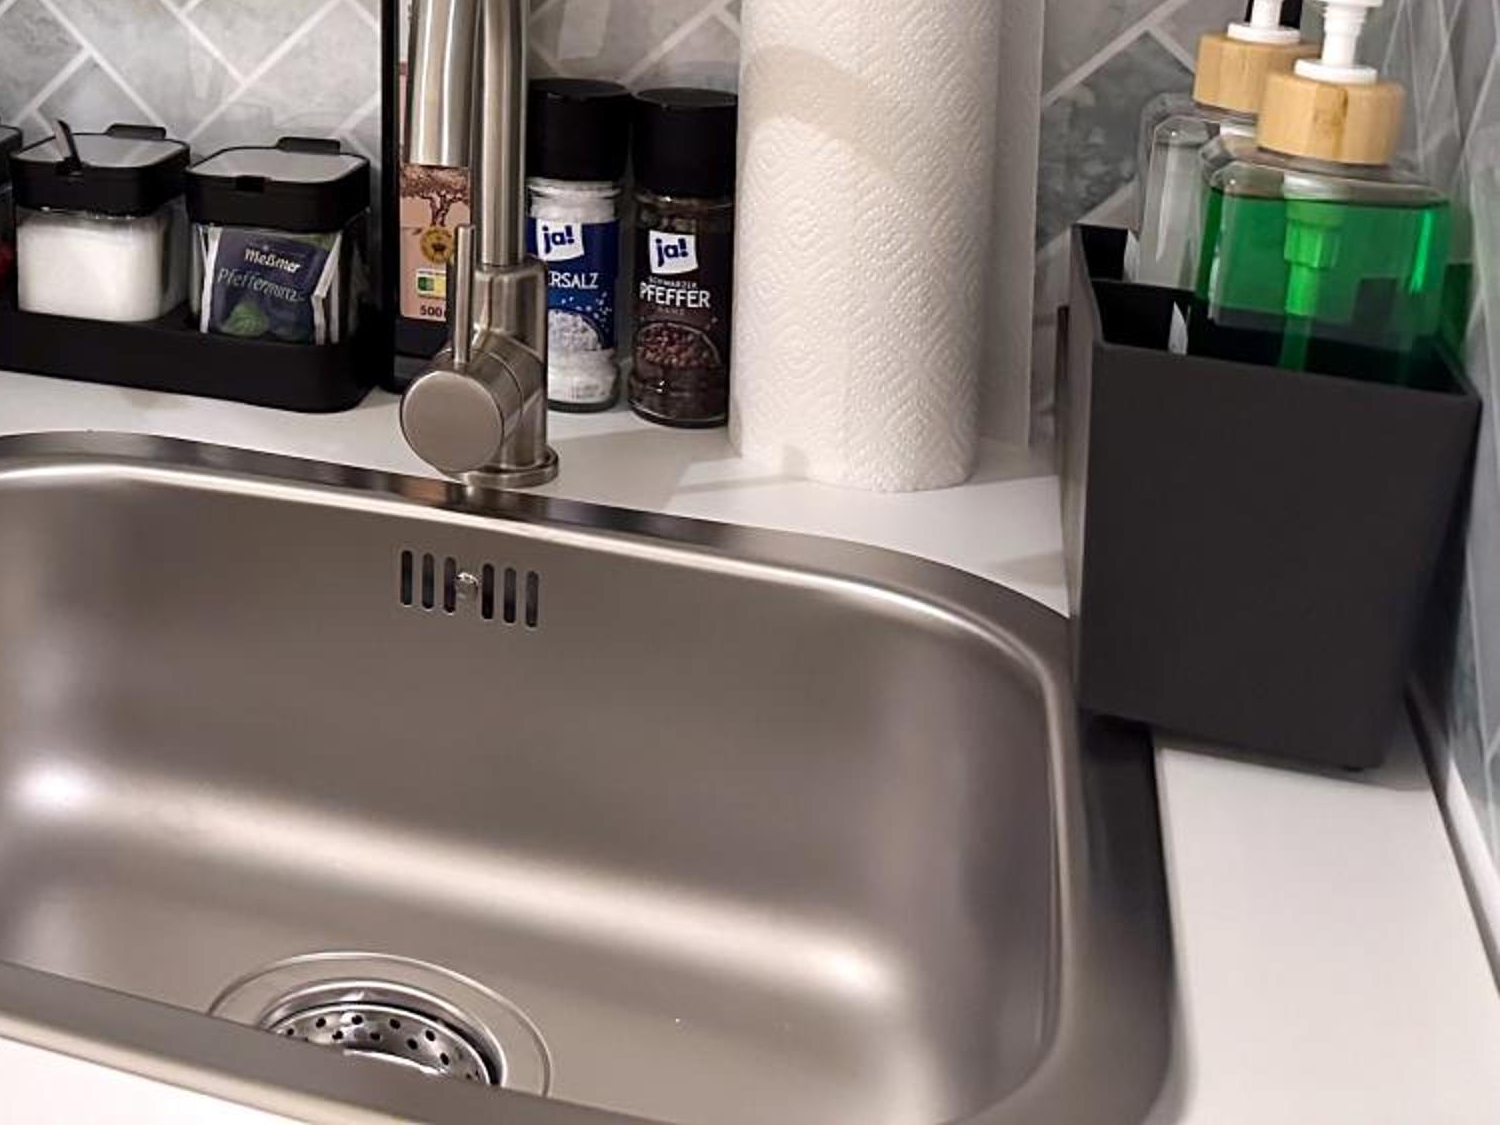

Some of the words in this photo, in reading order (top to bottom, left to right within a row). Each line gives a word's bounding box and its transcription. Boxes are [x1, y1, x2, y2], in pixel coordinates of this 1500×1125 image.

[542, 225, 575, 254] ja!
[655, 237, 689, 268] ja!
[640, 281, 711, 308] PFEFFER
